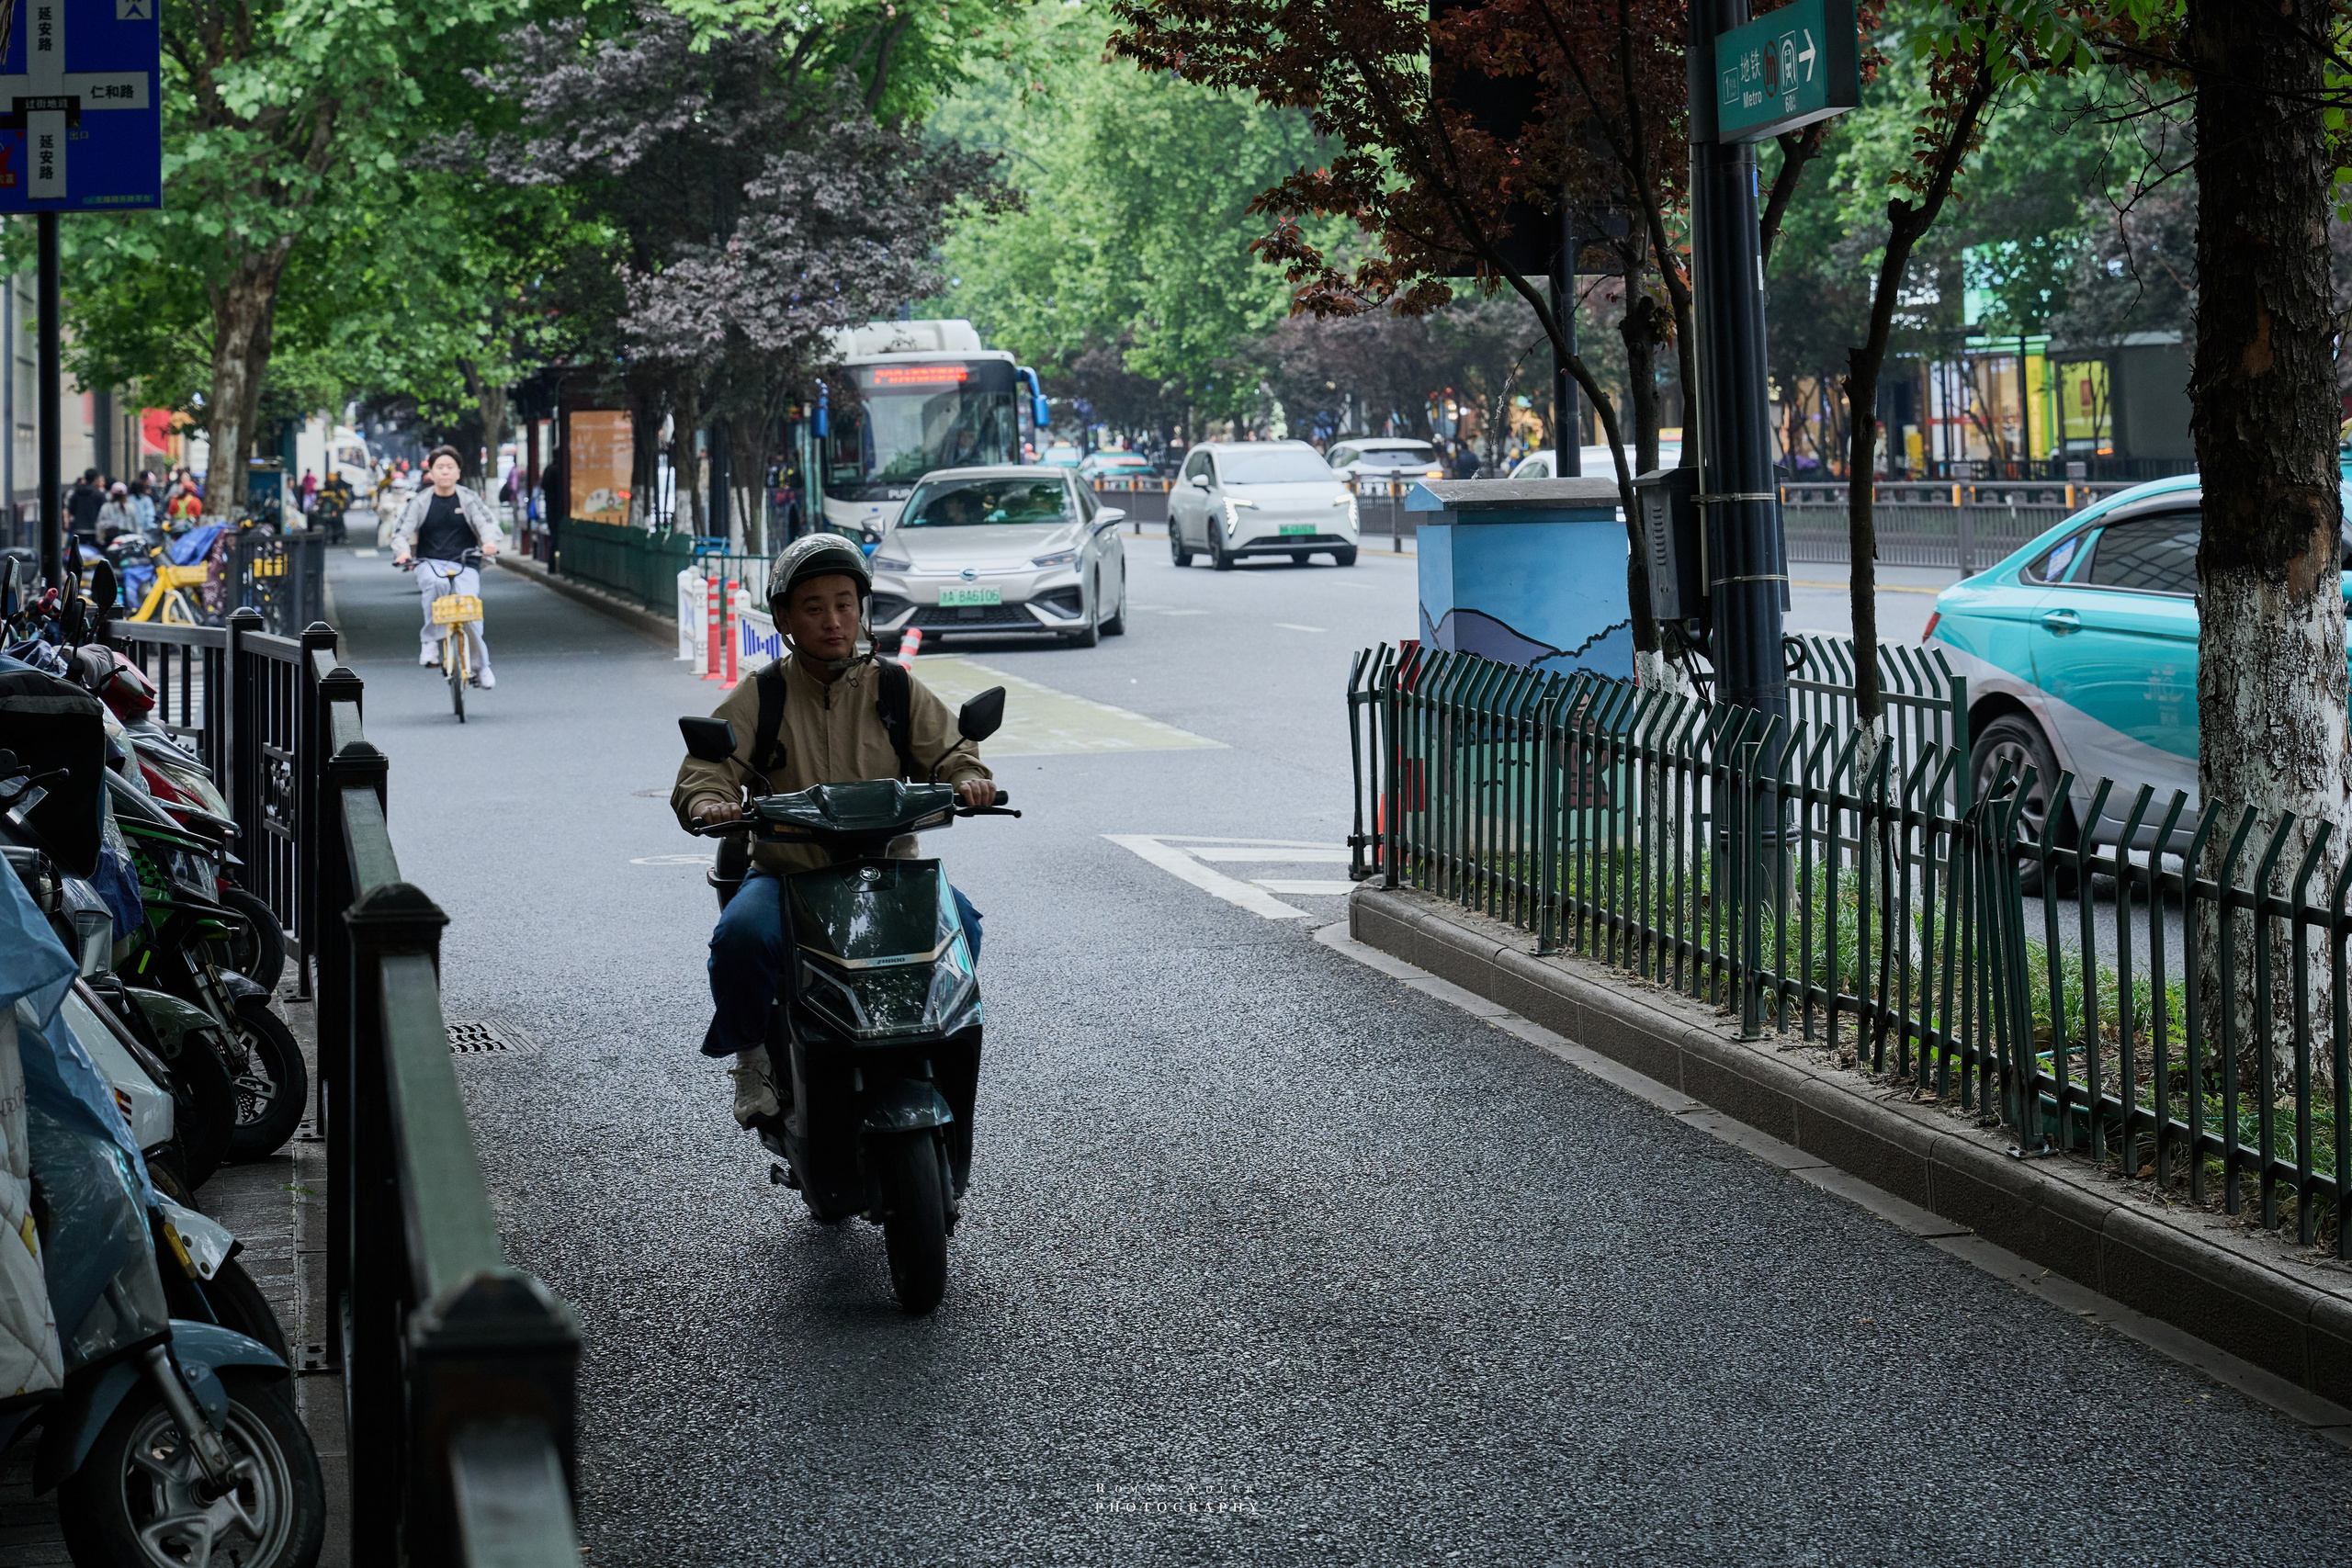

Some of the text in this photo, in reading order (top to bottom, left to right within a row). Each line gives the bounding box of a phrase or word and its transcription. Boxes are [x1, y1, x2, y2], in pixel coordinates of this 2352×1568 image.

[38, 6, 52, 51] 延安路
[1740, 48, 1761, 83] 地铁
[90, 85, 134, 99] 仁和路
[1743, 90, 1762, 108] Metro
[69, 130, 89, 141] 出口
[39, 135, 53, 179] 延安路
